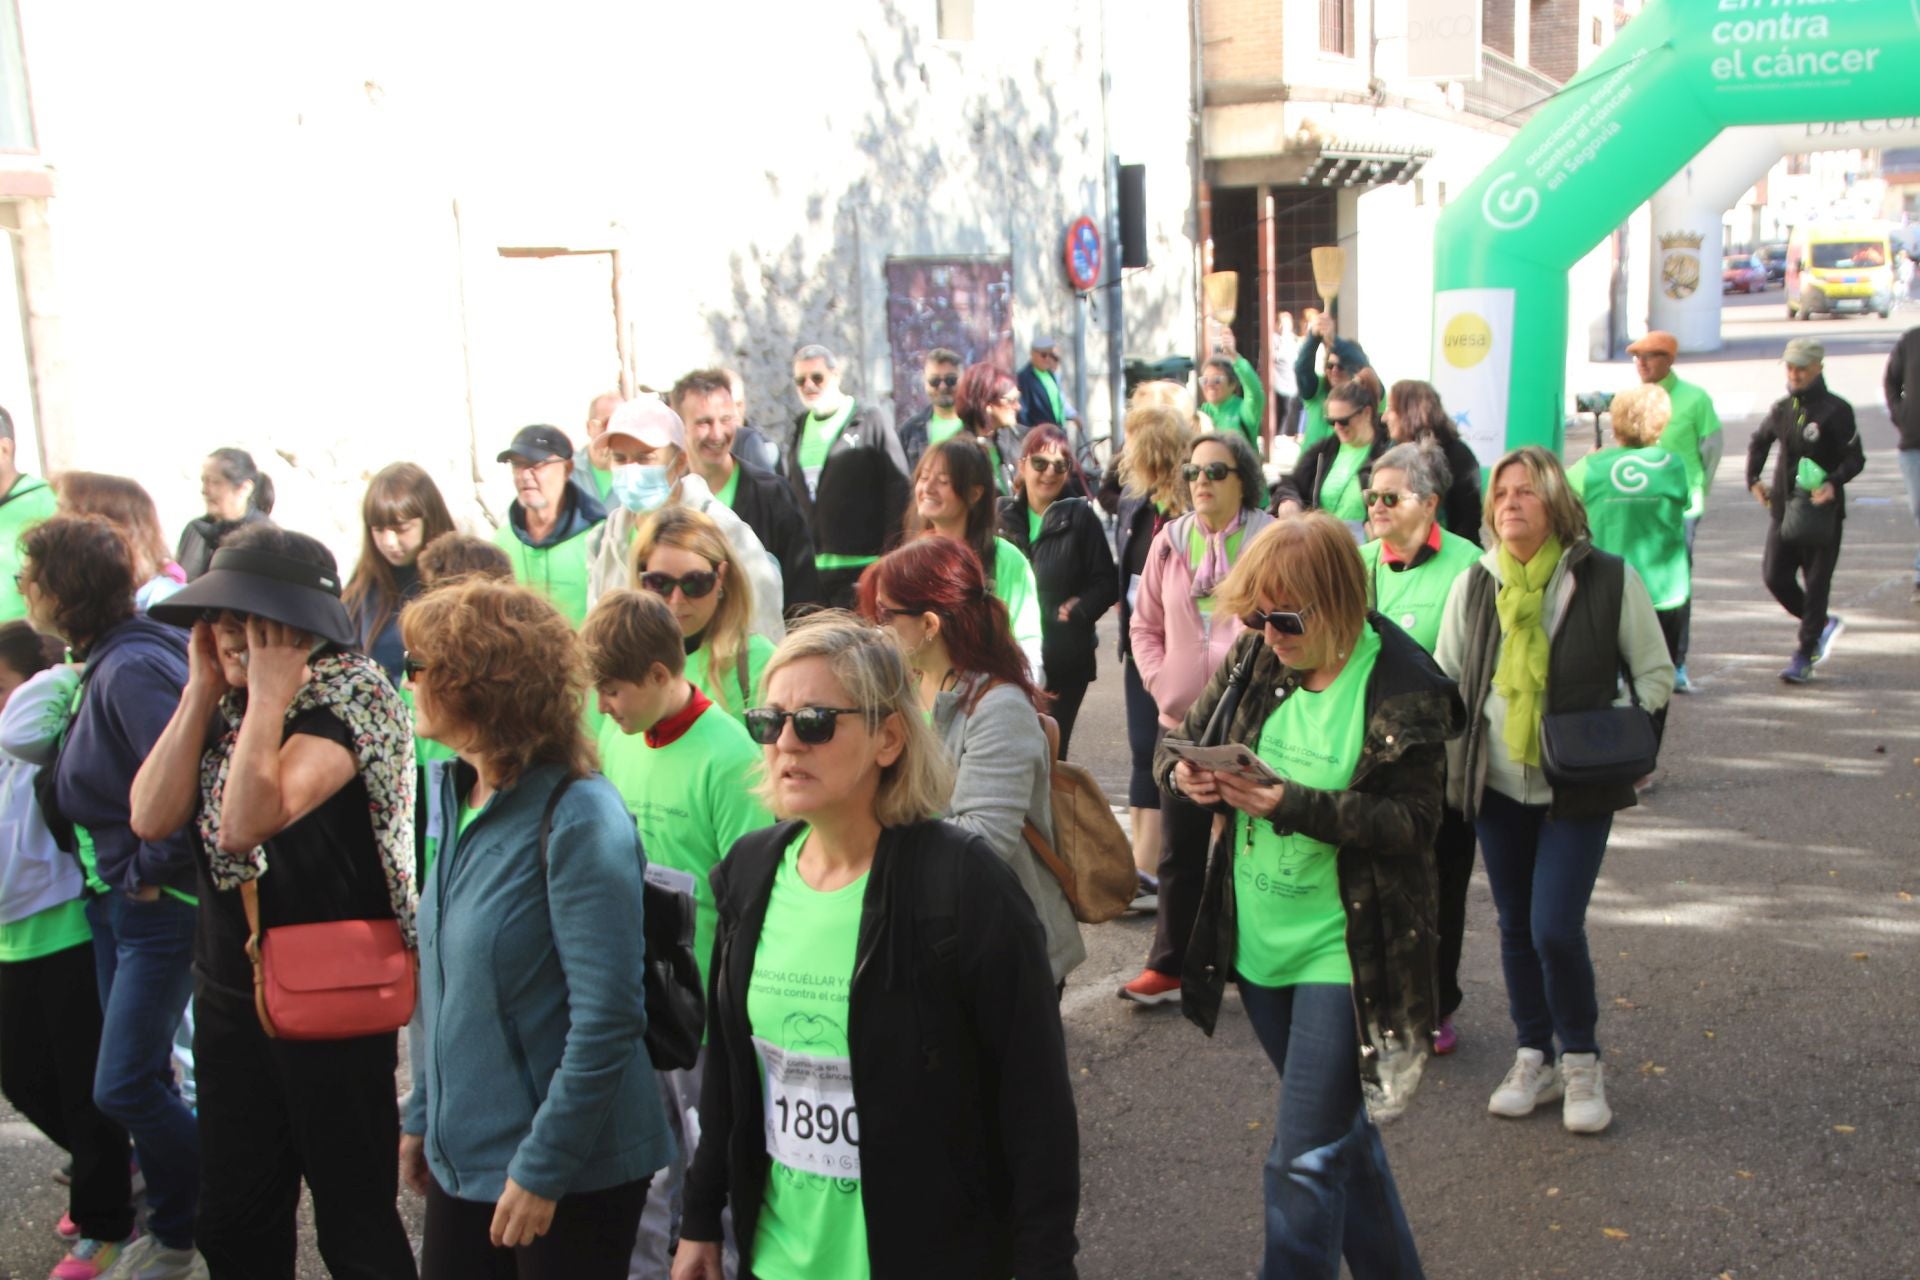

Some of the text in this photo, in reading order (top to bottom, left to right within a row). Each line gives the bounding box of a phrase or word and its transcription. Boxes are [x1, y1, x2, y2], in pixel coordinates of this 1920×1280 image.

[1711, 11, 1829, 44] contra
[1711, 46, 1881, 80] el cáncer
[1535, 138, 1577, 178] contra
[1547, 121, 1621, 191] en Segovia
[1444, 333, 1486, 347] uvesa
[783, 988, 816, 1000] contra
[818, 991, 829, 1001] el
[788, 972, 835, 986] CUÉLLAR
[775, 1095, 860, 1147] 1890
